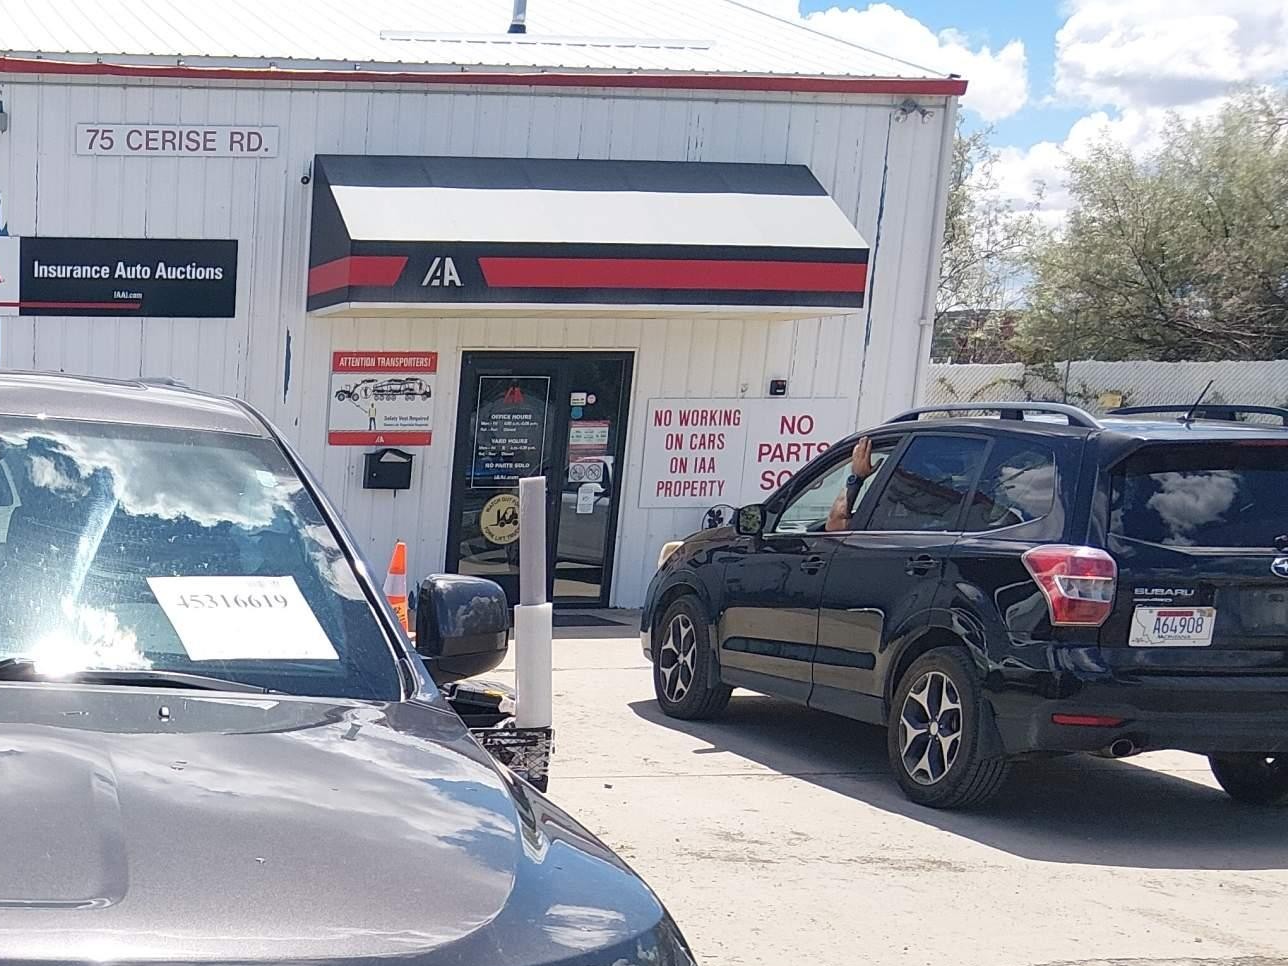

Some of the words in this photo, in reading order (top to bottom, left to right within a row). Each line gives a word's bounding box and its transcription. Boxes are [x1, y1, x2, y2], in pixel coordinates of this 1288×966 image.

[86, 129, 114, 151] 75
[126, 129, 217, 152] CERISE
[229, 131, 270, 153] RD.
[34, 260, 110, 279] Insurance
[114, 261, 151, 280] Auto
[155, 262, 223, 281] Auctions
[339, 356, 376, 367] ATTENTION
[377, 356, 431, 367] TRANSPORTERS!
[654, 410, 672, 427] NO
[679, 409, 741, 426] WORKING
[780, 415, 814, 435] NO
[665, 433, 683, 450] ON
[690, 433, 725, 450] CARS
[669, 457, 687, 473] ON
[694, 457, 716, 473] IAA
[656, 480, 725, 497] PROPERTY
[1134, 587, 1195, 596] SUBARU
[176, 594, 289, 609] 45316619
[1153, 617, 1204, 634] A64908
